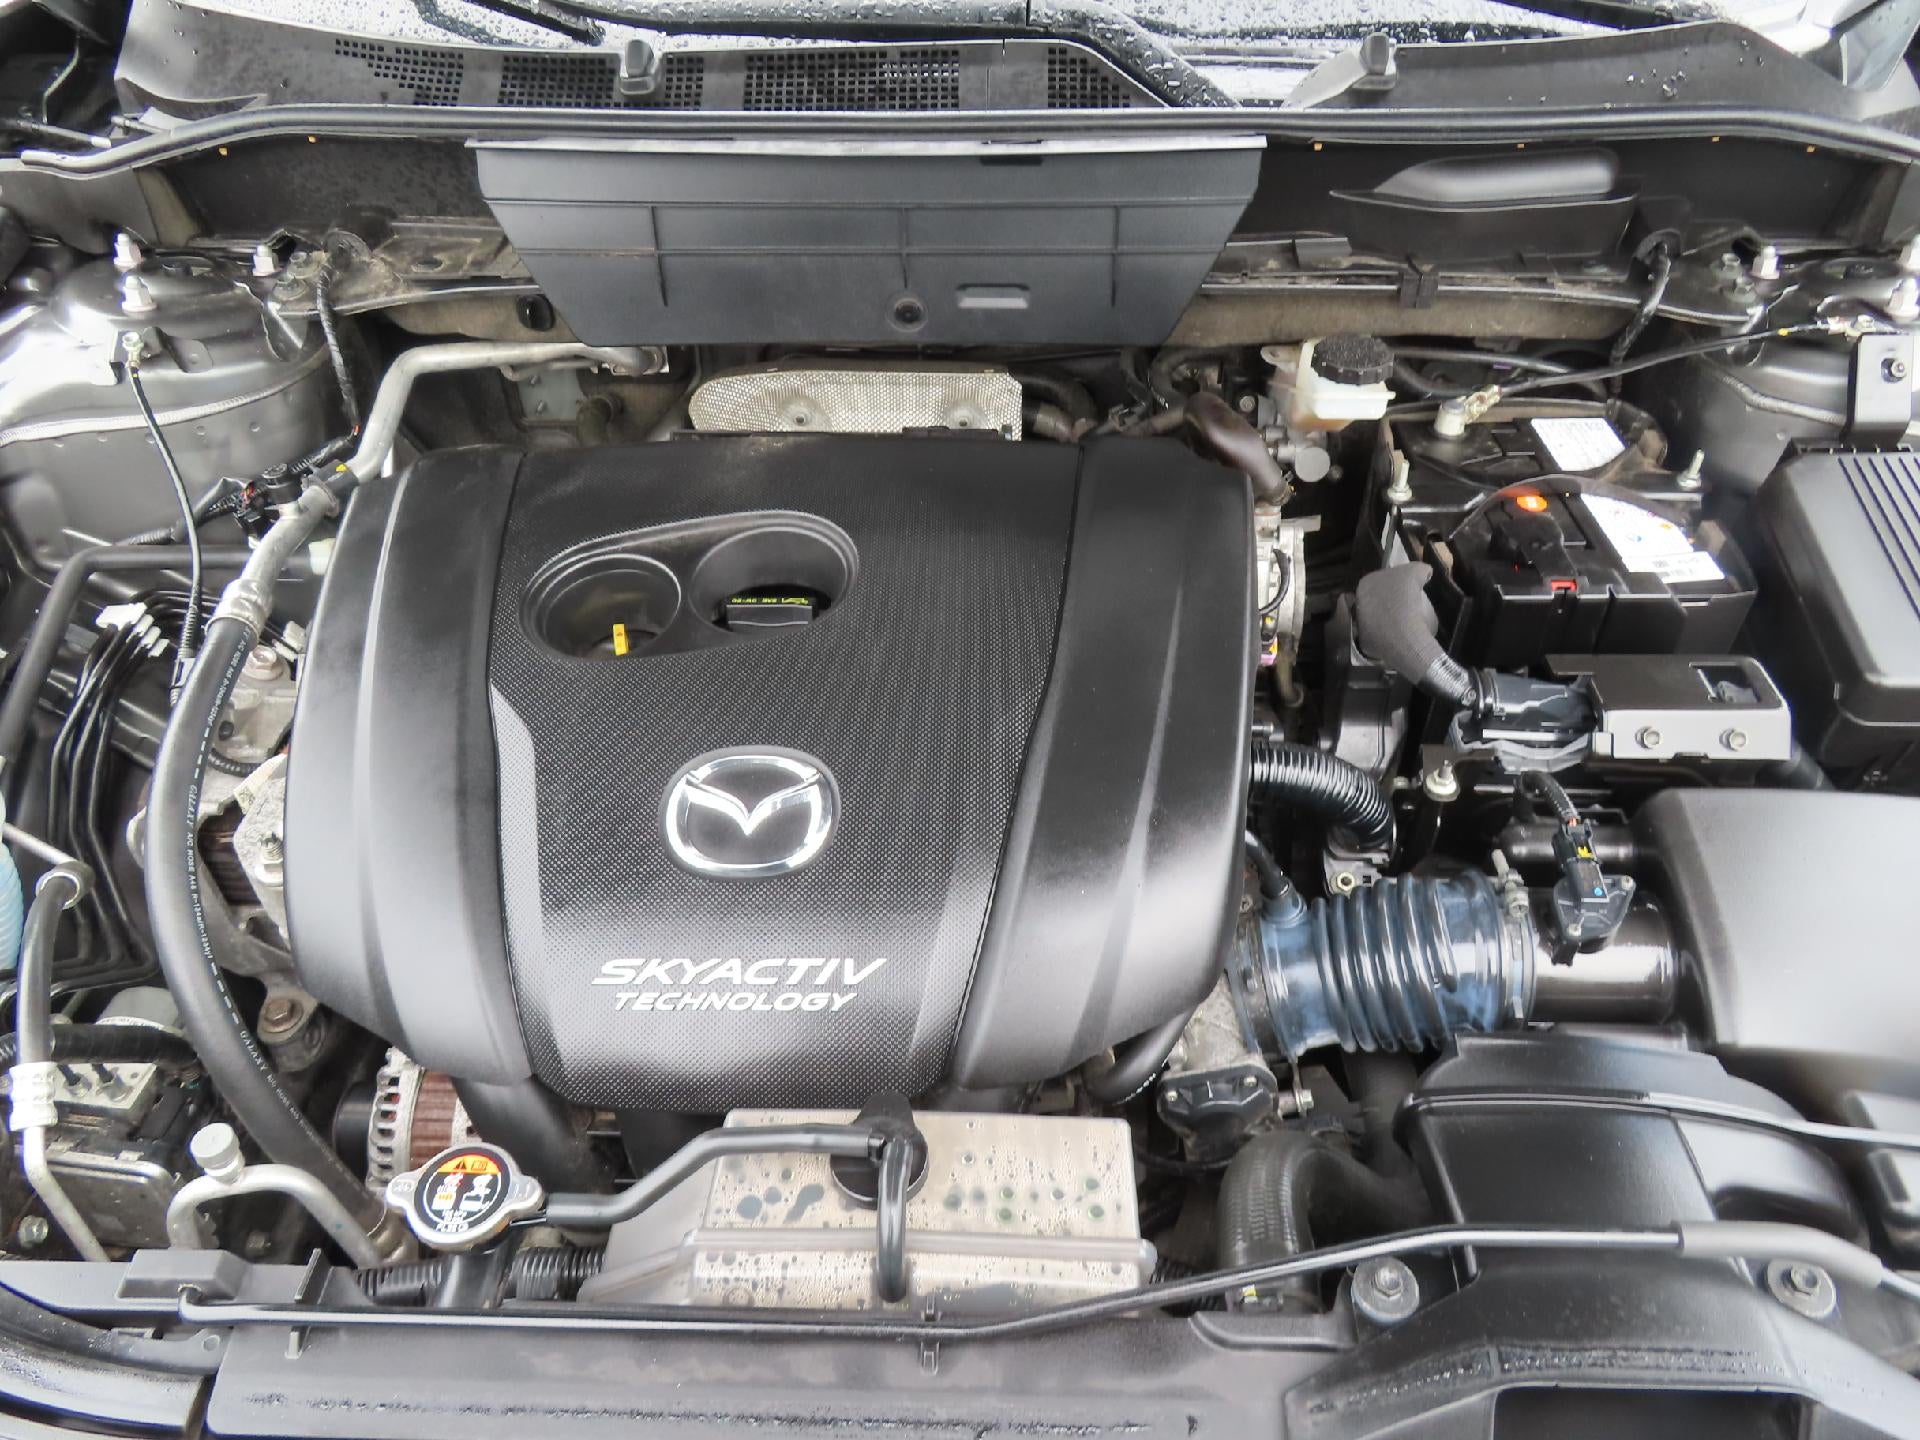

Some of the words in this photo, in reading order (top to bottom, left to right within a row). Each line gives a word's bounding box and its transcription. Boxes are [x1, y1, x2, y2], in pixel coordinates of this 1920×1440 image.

[186, 784, 198, 830] GALAXY
[186, 832, 194, 847] A/C
[186, 849, 196, 873] HOSE
[591, 957, 887, 986] SKYACTIV
[615, 992, 858, 1012] TECHNOLOGY
[240, 1030, 268, 1072] GALAXY
